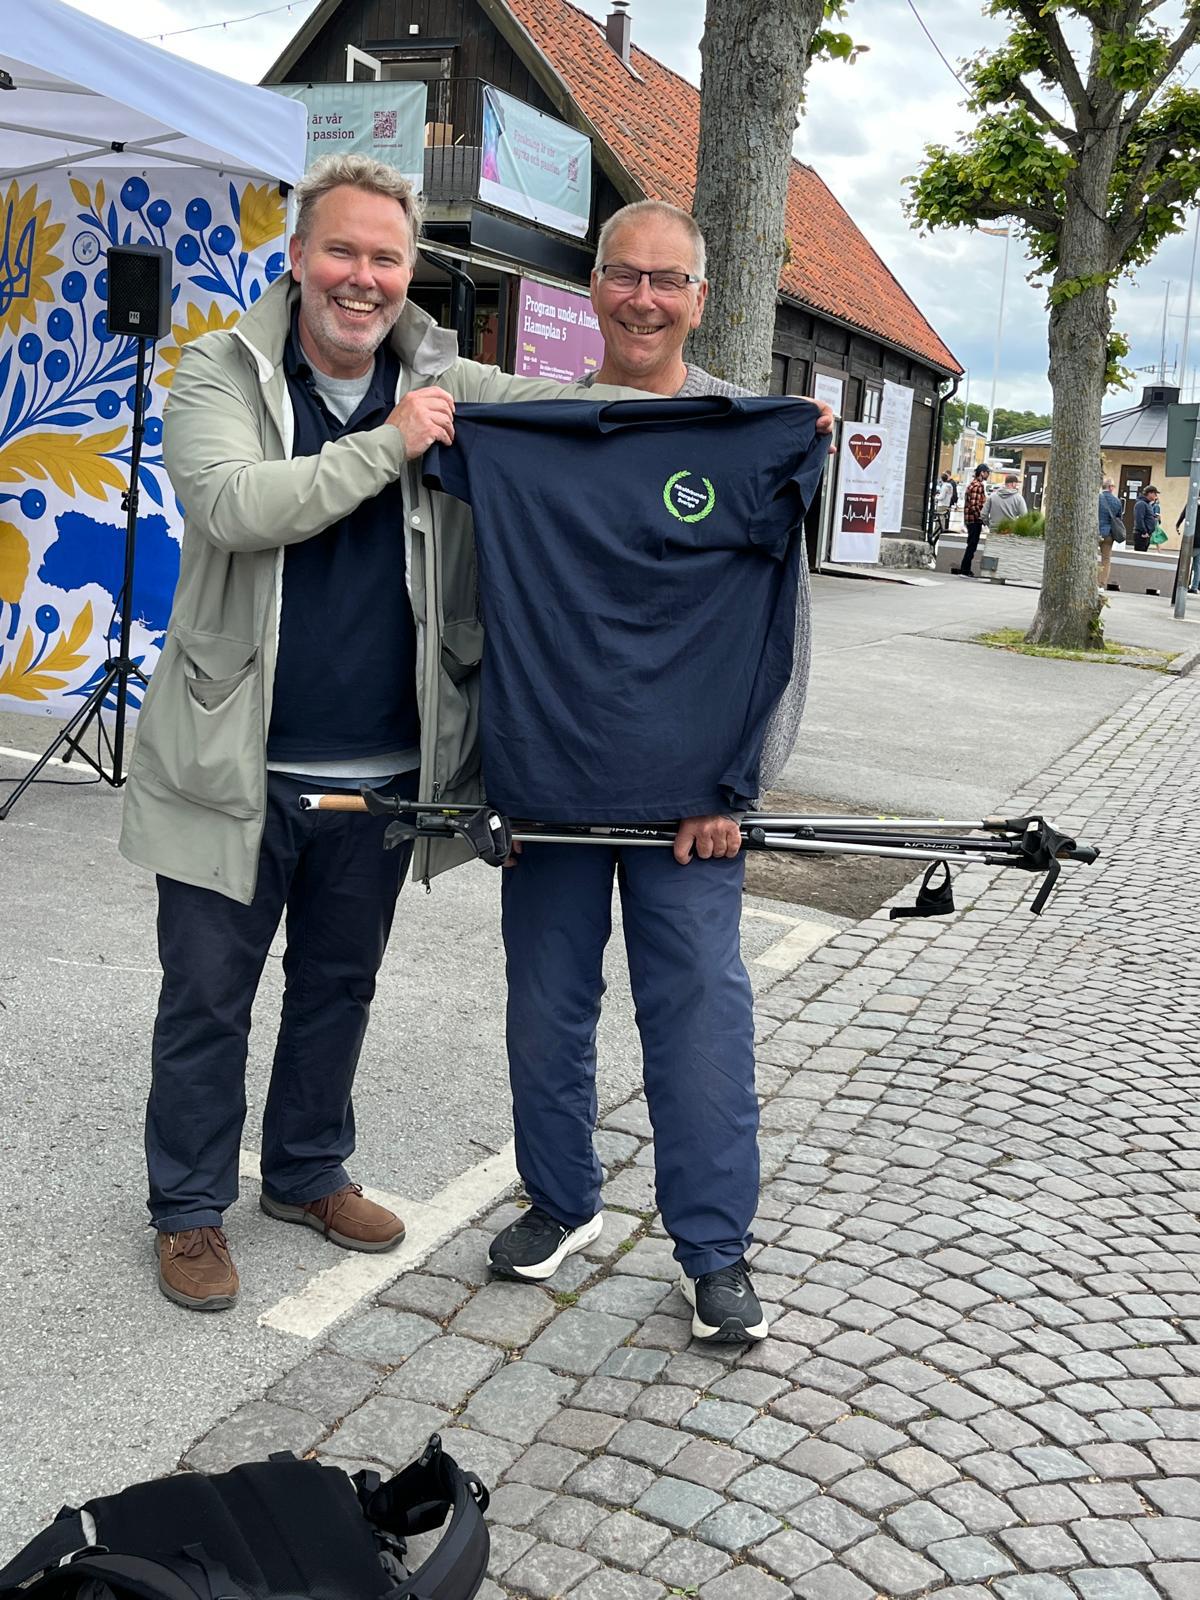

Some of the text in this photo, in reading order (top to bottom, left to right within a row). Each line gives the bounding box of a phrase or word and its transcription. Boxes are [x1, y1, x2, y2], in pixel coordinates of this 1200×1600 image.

[312, 112, 343, 124] är vår
[313, 128, 354, 141] passion
[525, 294, 556, 317] Program
[557, 306, 578, 324] under
[523, 315, 567, 341] Hamnplan 5
